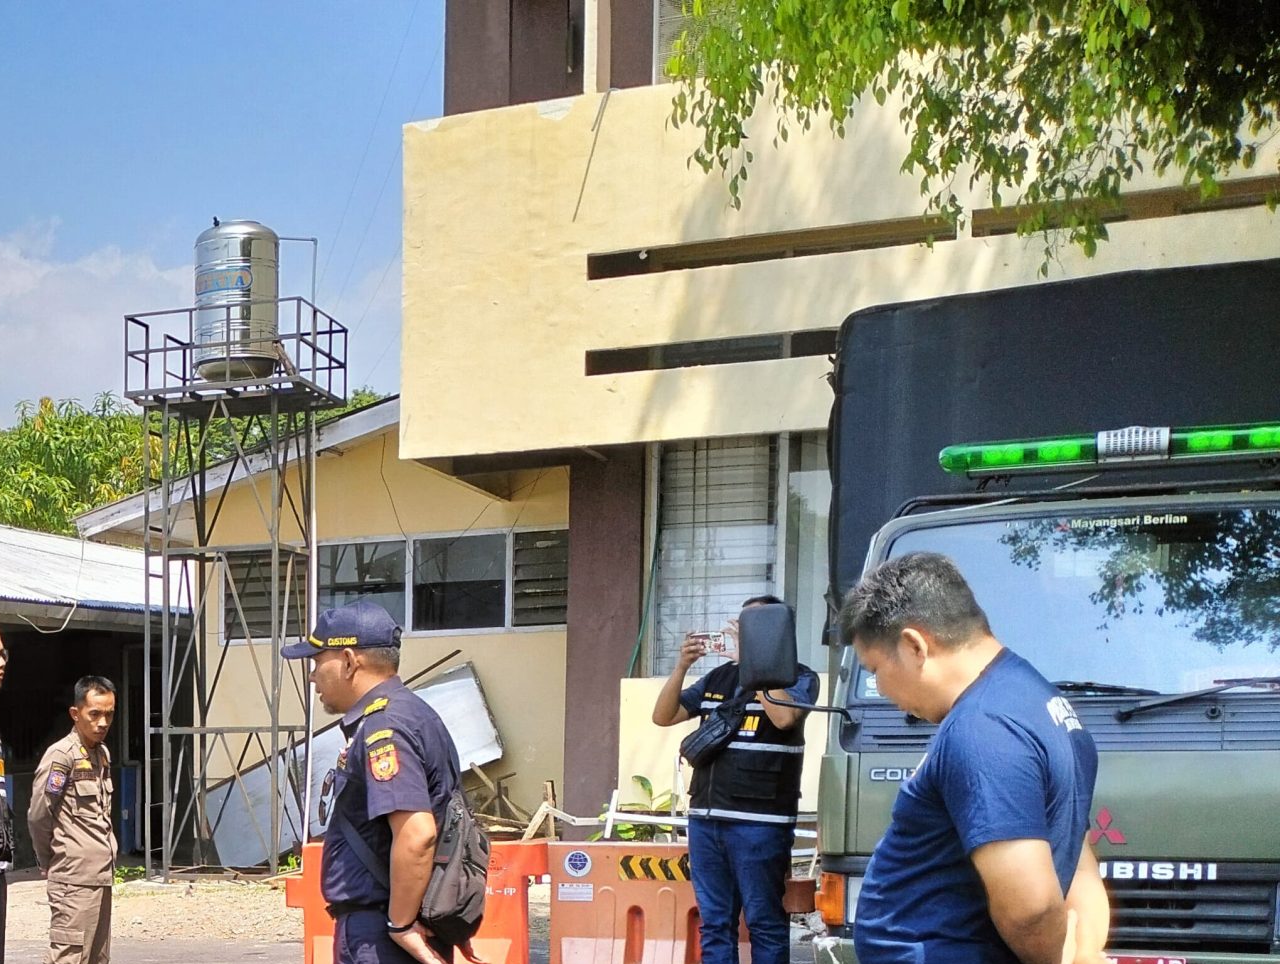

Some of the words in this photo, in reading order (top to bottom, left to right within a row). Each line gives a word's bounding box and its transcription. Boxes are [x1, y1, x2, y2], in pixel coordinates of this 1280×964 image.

[1071, 516, 1140, 530] Mayangsari
[1143, 513, 1188, 525] Berlian
[327, 636, 358, 646] CUSTOMS
